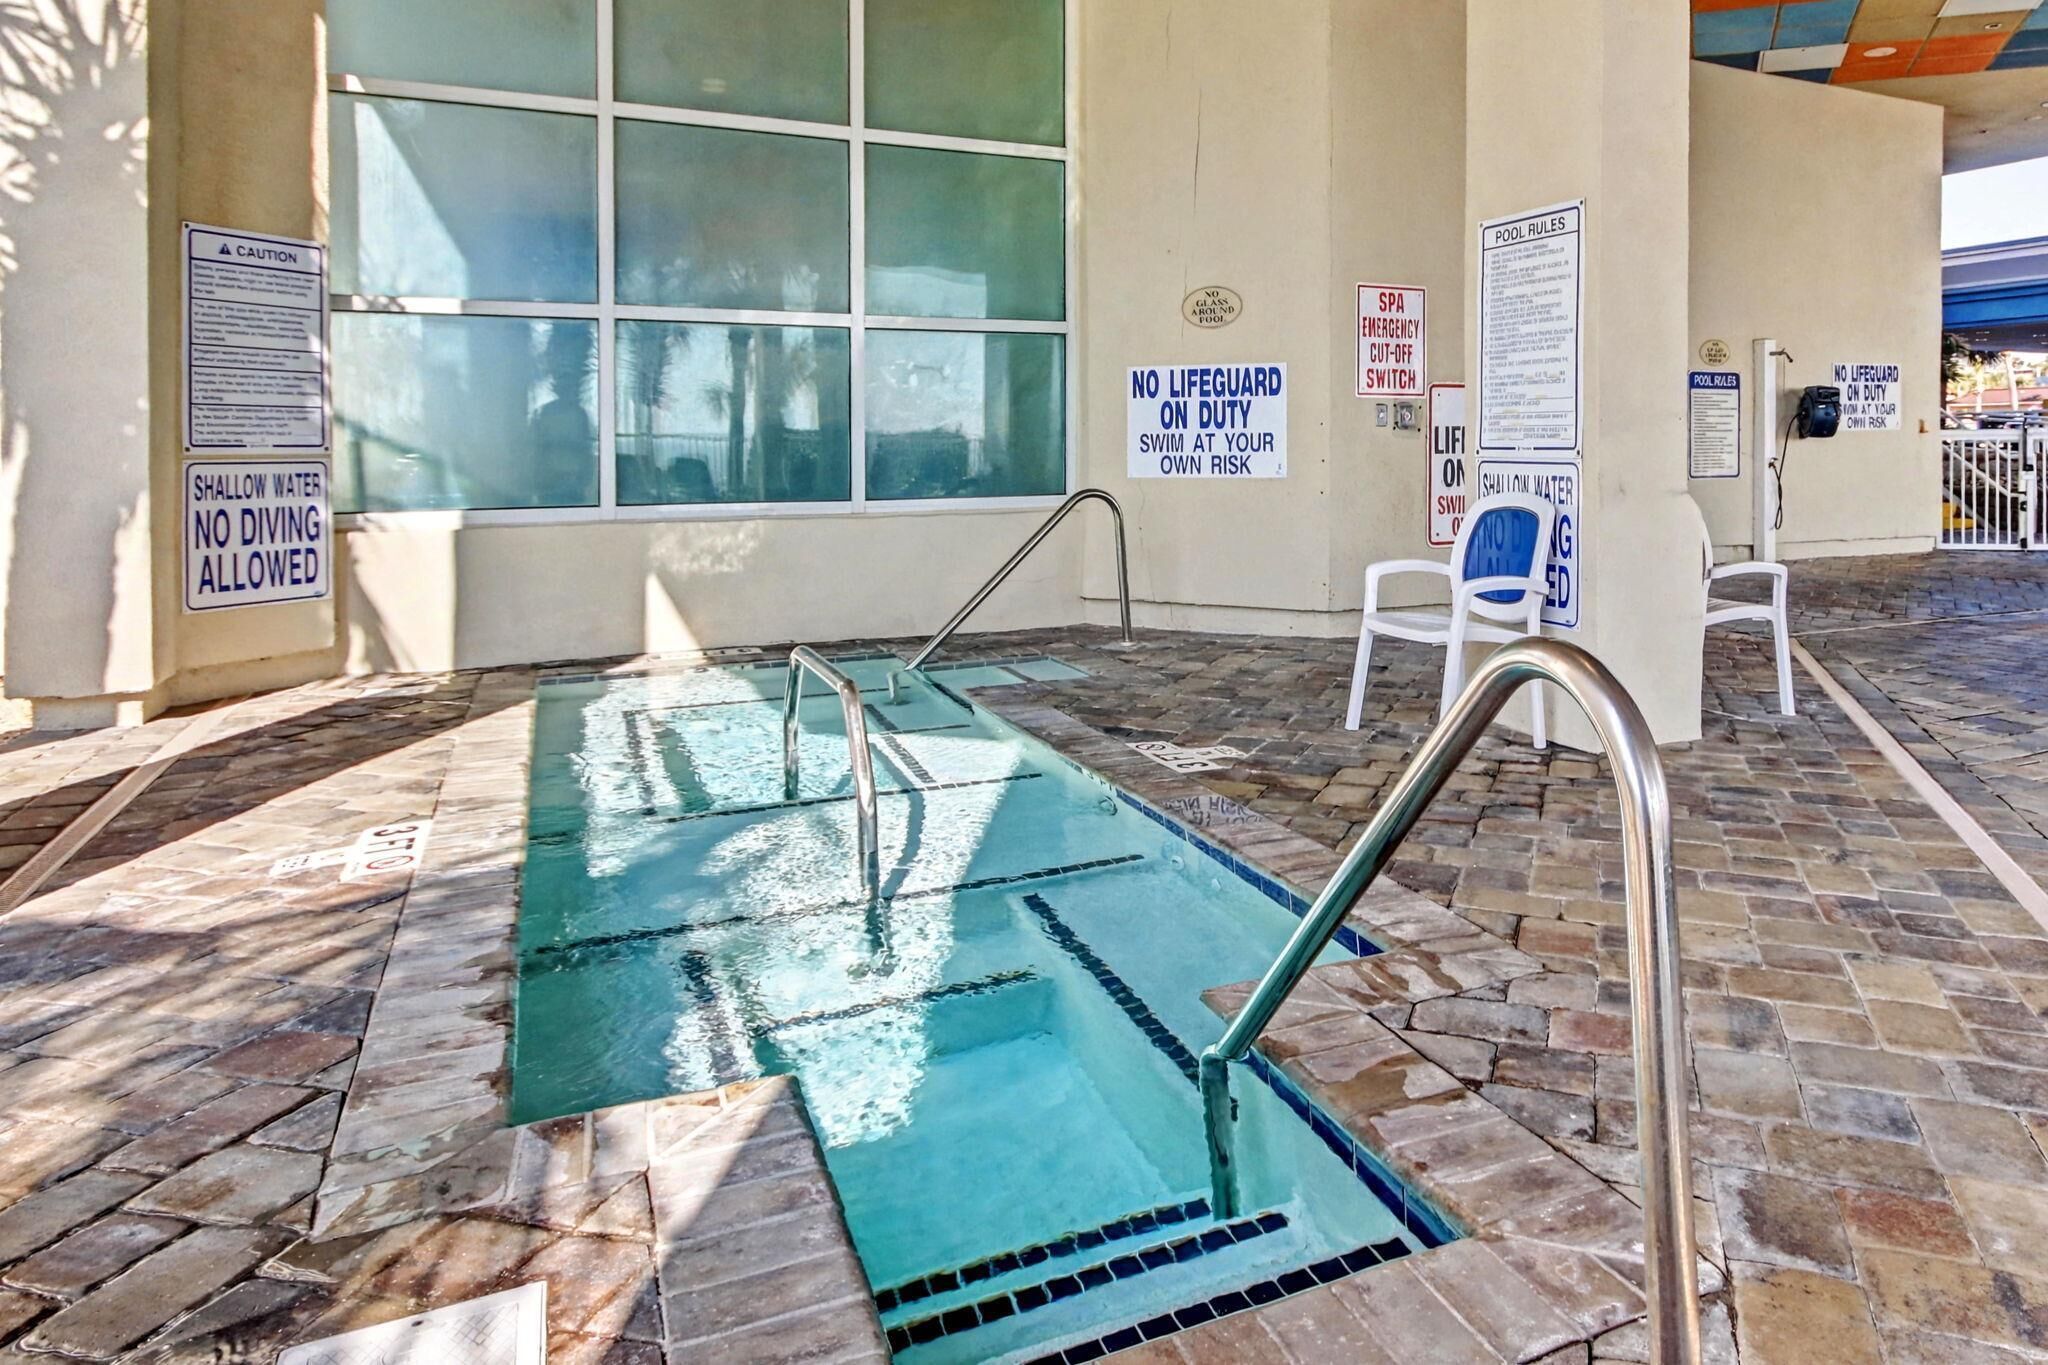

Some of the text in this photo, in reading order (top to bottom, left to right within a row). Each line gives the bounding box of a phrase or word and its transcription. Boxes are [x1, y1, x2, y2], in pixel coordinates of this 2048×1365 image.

[1495, 216, 1566, 244] POOL RULES
[236, 245, 297, 264] CAUTION
[1195, 298, 1229, 307] GLASS
[1204, 290, 1219, 298] NO
[1379, 292, 1405, 313] SPA
[1191, 305, 1235, 316] AROUND
[1199, 315, 1225, 324] POOL
[1362, 316, 1420, 340] EMERGENCY
[1370, 342, 1413, 364] CUT-OFF
[1132, 367, 1282, 399] NO LIFEGUARD
[1366, 368, 1416, 389] SWITCH
[1694, 375, 1737, 387] POOL RULES
[1834, 365, 1899, 383] NO LIFEGUARD
[1847, 384, 1887, 401] ON DUTY
[1160, 399, 1252, 430] ON DUTY
[1861, 403, 1871, 415] AT
[1875, 403, 1896, 415] YOUR
[1847, 416, 1887, 429] OWN RISK
[1139, 432, 1274, 453] SWIM AT YOUR
[1160, 455, 1252, 475] OWN RISK
[194, 472, 320, 501] SHALLOW WATER
[1483, 473, 1573, 505] SHALLOW WATER
[195, 505, 320, 550] NO DIVING
[1483, 514, 1505, 551] NO
[198, 547, 319, 595] ALLOWED
